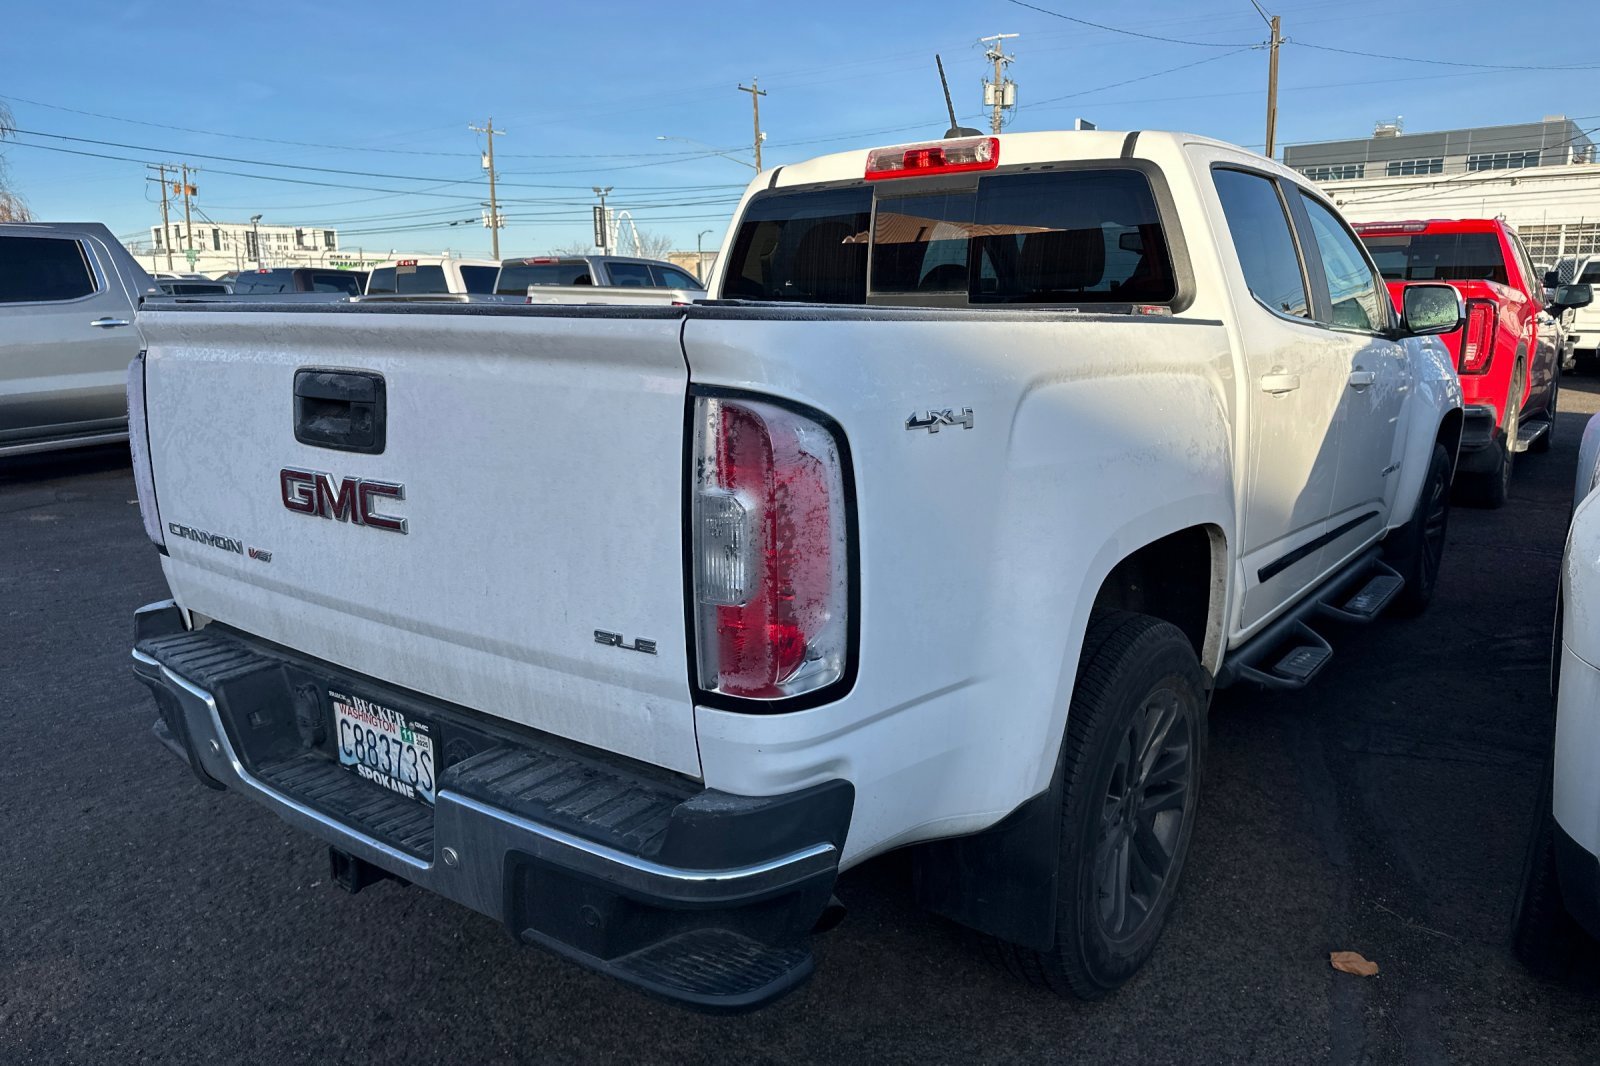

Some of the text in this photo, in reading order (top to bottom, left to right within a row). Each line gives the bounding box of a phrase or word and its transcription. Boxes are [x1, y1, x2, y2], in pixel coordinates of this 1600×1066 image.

[280, 465, 408, 535] GMC
[168, 522, 272, 563] CANYON V6
[594, 629, 657, 655] SLE
[340, 703, 396, 735] WASHINGTON
[352, 696, 407, 729] BECKER
[414, 721, 429, 732] GMC
[402, 728, 412, 741] 11
[340, 718, 433, 792] C88373S
[357, 763, 415, 798] SPOKANE
